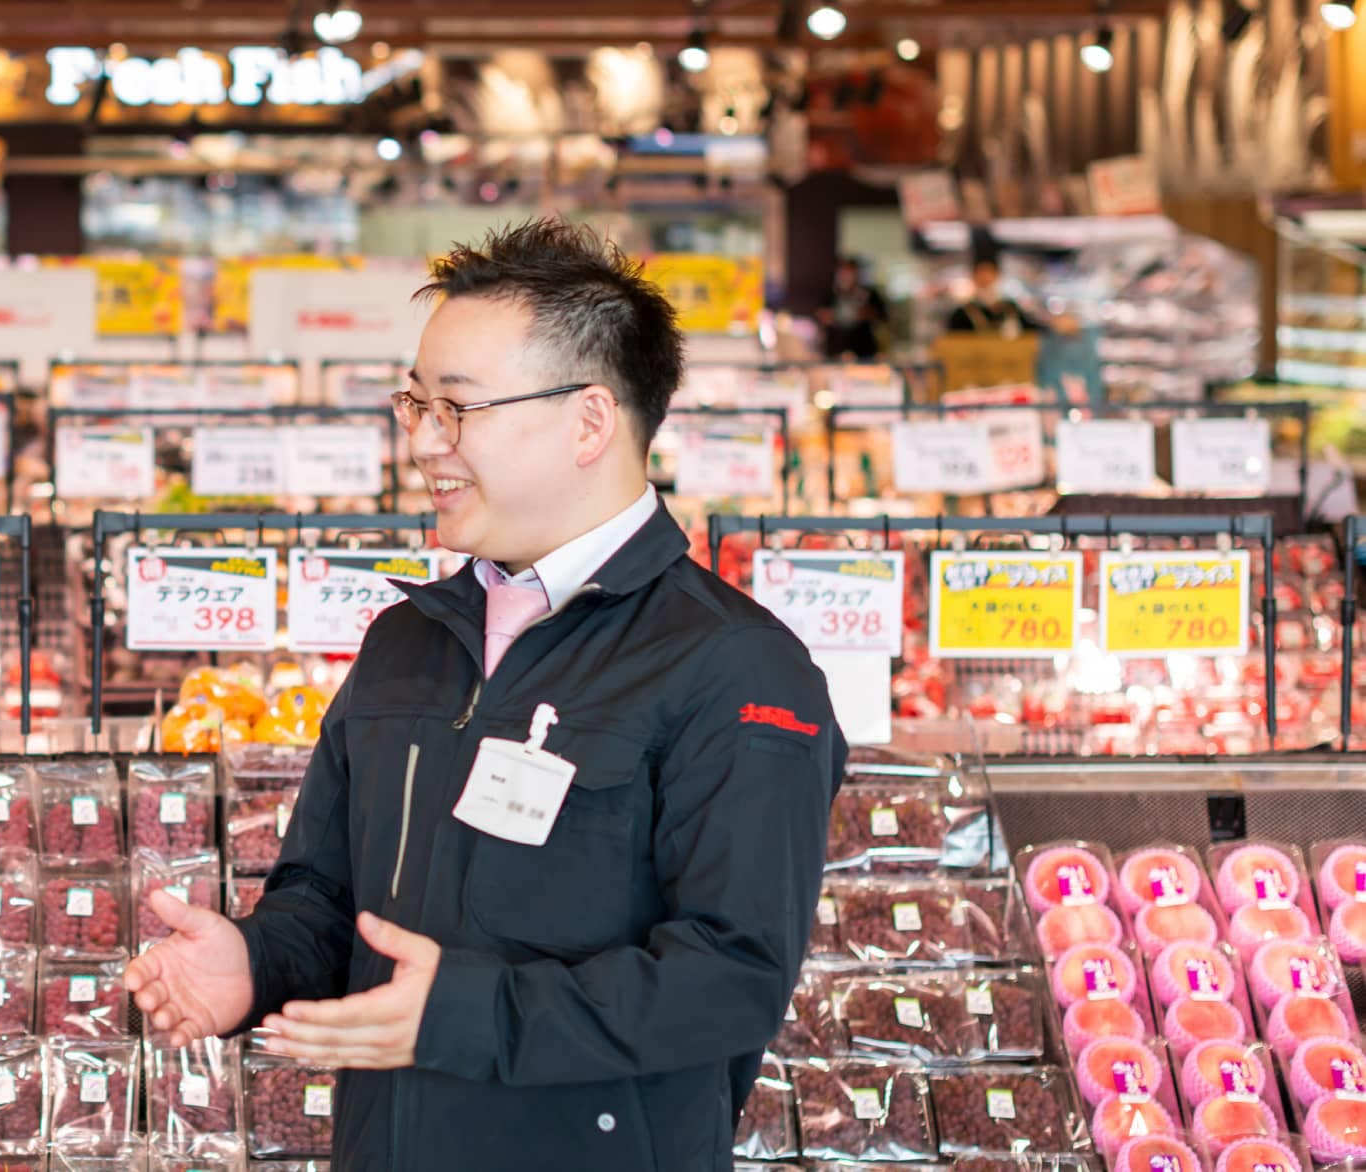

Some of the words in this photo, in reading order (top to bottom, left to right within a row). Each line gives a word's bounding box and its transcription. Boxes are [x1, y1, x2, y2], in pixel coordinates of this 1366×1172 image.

[194, 607, 256, 632] 398
[820, 610, 882, 636] 398
[1000, 618, 1062, 641] 780
[1167, 618, 1228, 641] 780
